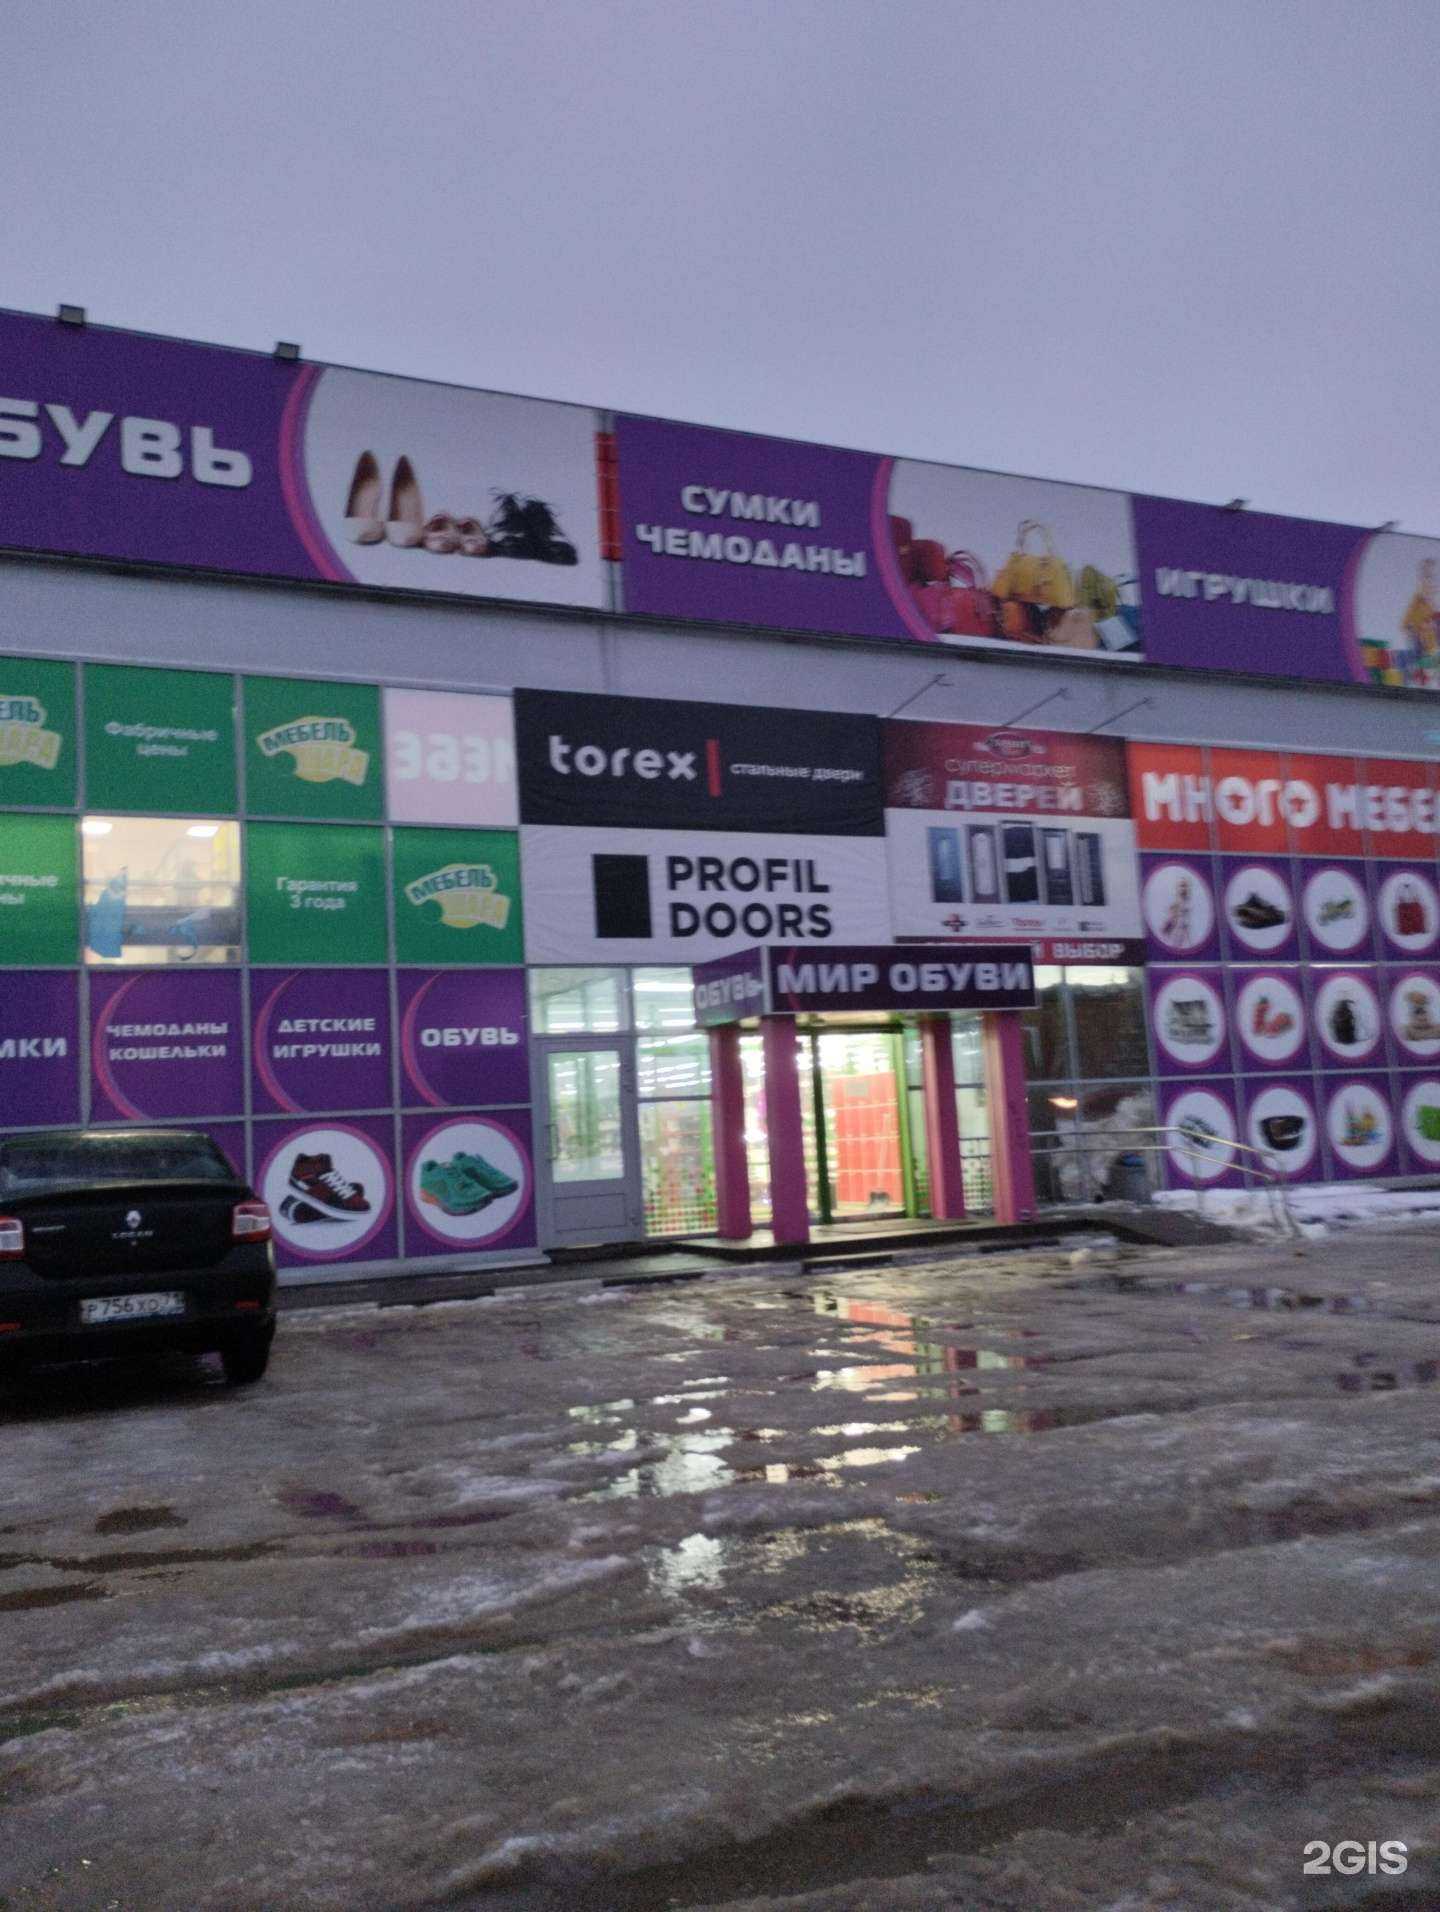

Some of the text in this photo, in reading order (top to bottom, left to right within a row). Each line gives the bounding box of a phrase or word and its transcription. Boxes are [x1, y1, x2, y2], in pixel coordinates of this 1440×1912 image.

[681, 485, 821, 528] СУМКИ
[636, 523, 867, 577] ЧЕМОДАНЫ
[1155, 567, 1335, 614] ИГРУШКИ
[550, 735, 697, 781] torex
[944, 780, 1083, 811] ДВЕРЕЙ
[1142, 771, 1440, 834] МНОГО МЕБЕ
[666, 856, 830, 893] PROFIL
[669, 902, 832, 938] DOORS
[776, 961, 1031, 995] МИР ОБУВИ
[106, 1022, 228, 1037] ЧЕМОДАНЫ
[278, 1018, 376, 1033] ДЕТСКИЕ
[420, 1027, 519, 1046] ОБУВЬ
[109, 1045, 226, 1060] КОШЕЛЬКИ
[273, 1043, 381, 1058] ИГРУШКИ
